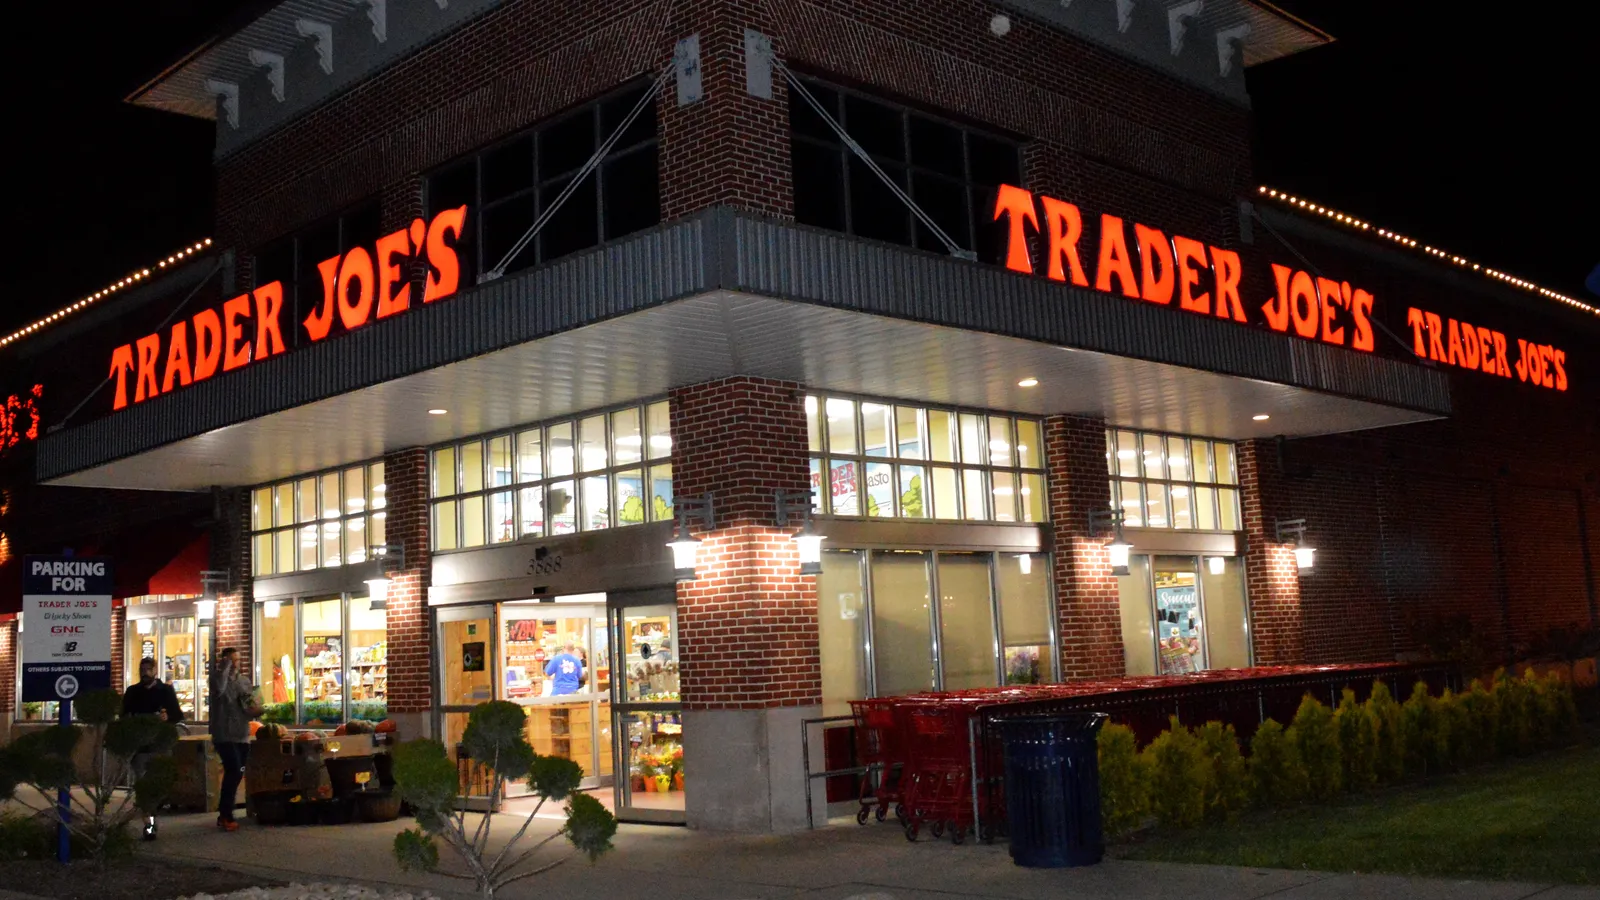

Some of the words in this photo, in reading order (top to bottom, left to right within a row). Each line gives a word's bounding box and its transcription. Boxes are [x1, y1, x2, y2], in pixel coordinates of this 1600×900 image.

[994, 184, 1247, 323] TRADER
[1262, 263, 1375, 352] JOE'S
[109, 281, 286, 410] TRADER
[303, 204, 467, 341] JOE'S
[1408, 308, 1512, 378] TRADER
[1516, 339, 1568, 391] JOE'S
[32, 561, 105, 576] PARKING
[52, 577, 86, 591] FOR
[74, 600, 98, 608] JOE'S
[52, 612, 71, 622] Lucky
[72, 612, 91, 620] Shoes
[51, 625, 85, 633] GNC
